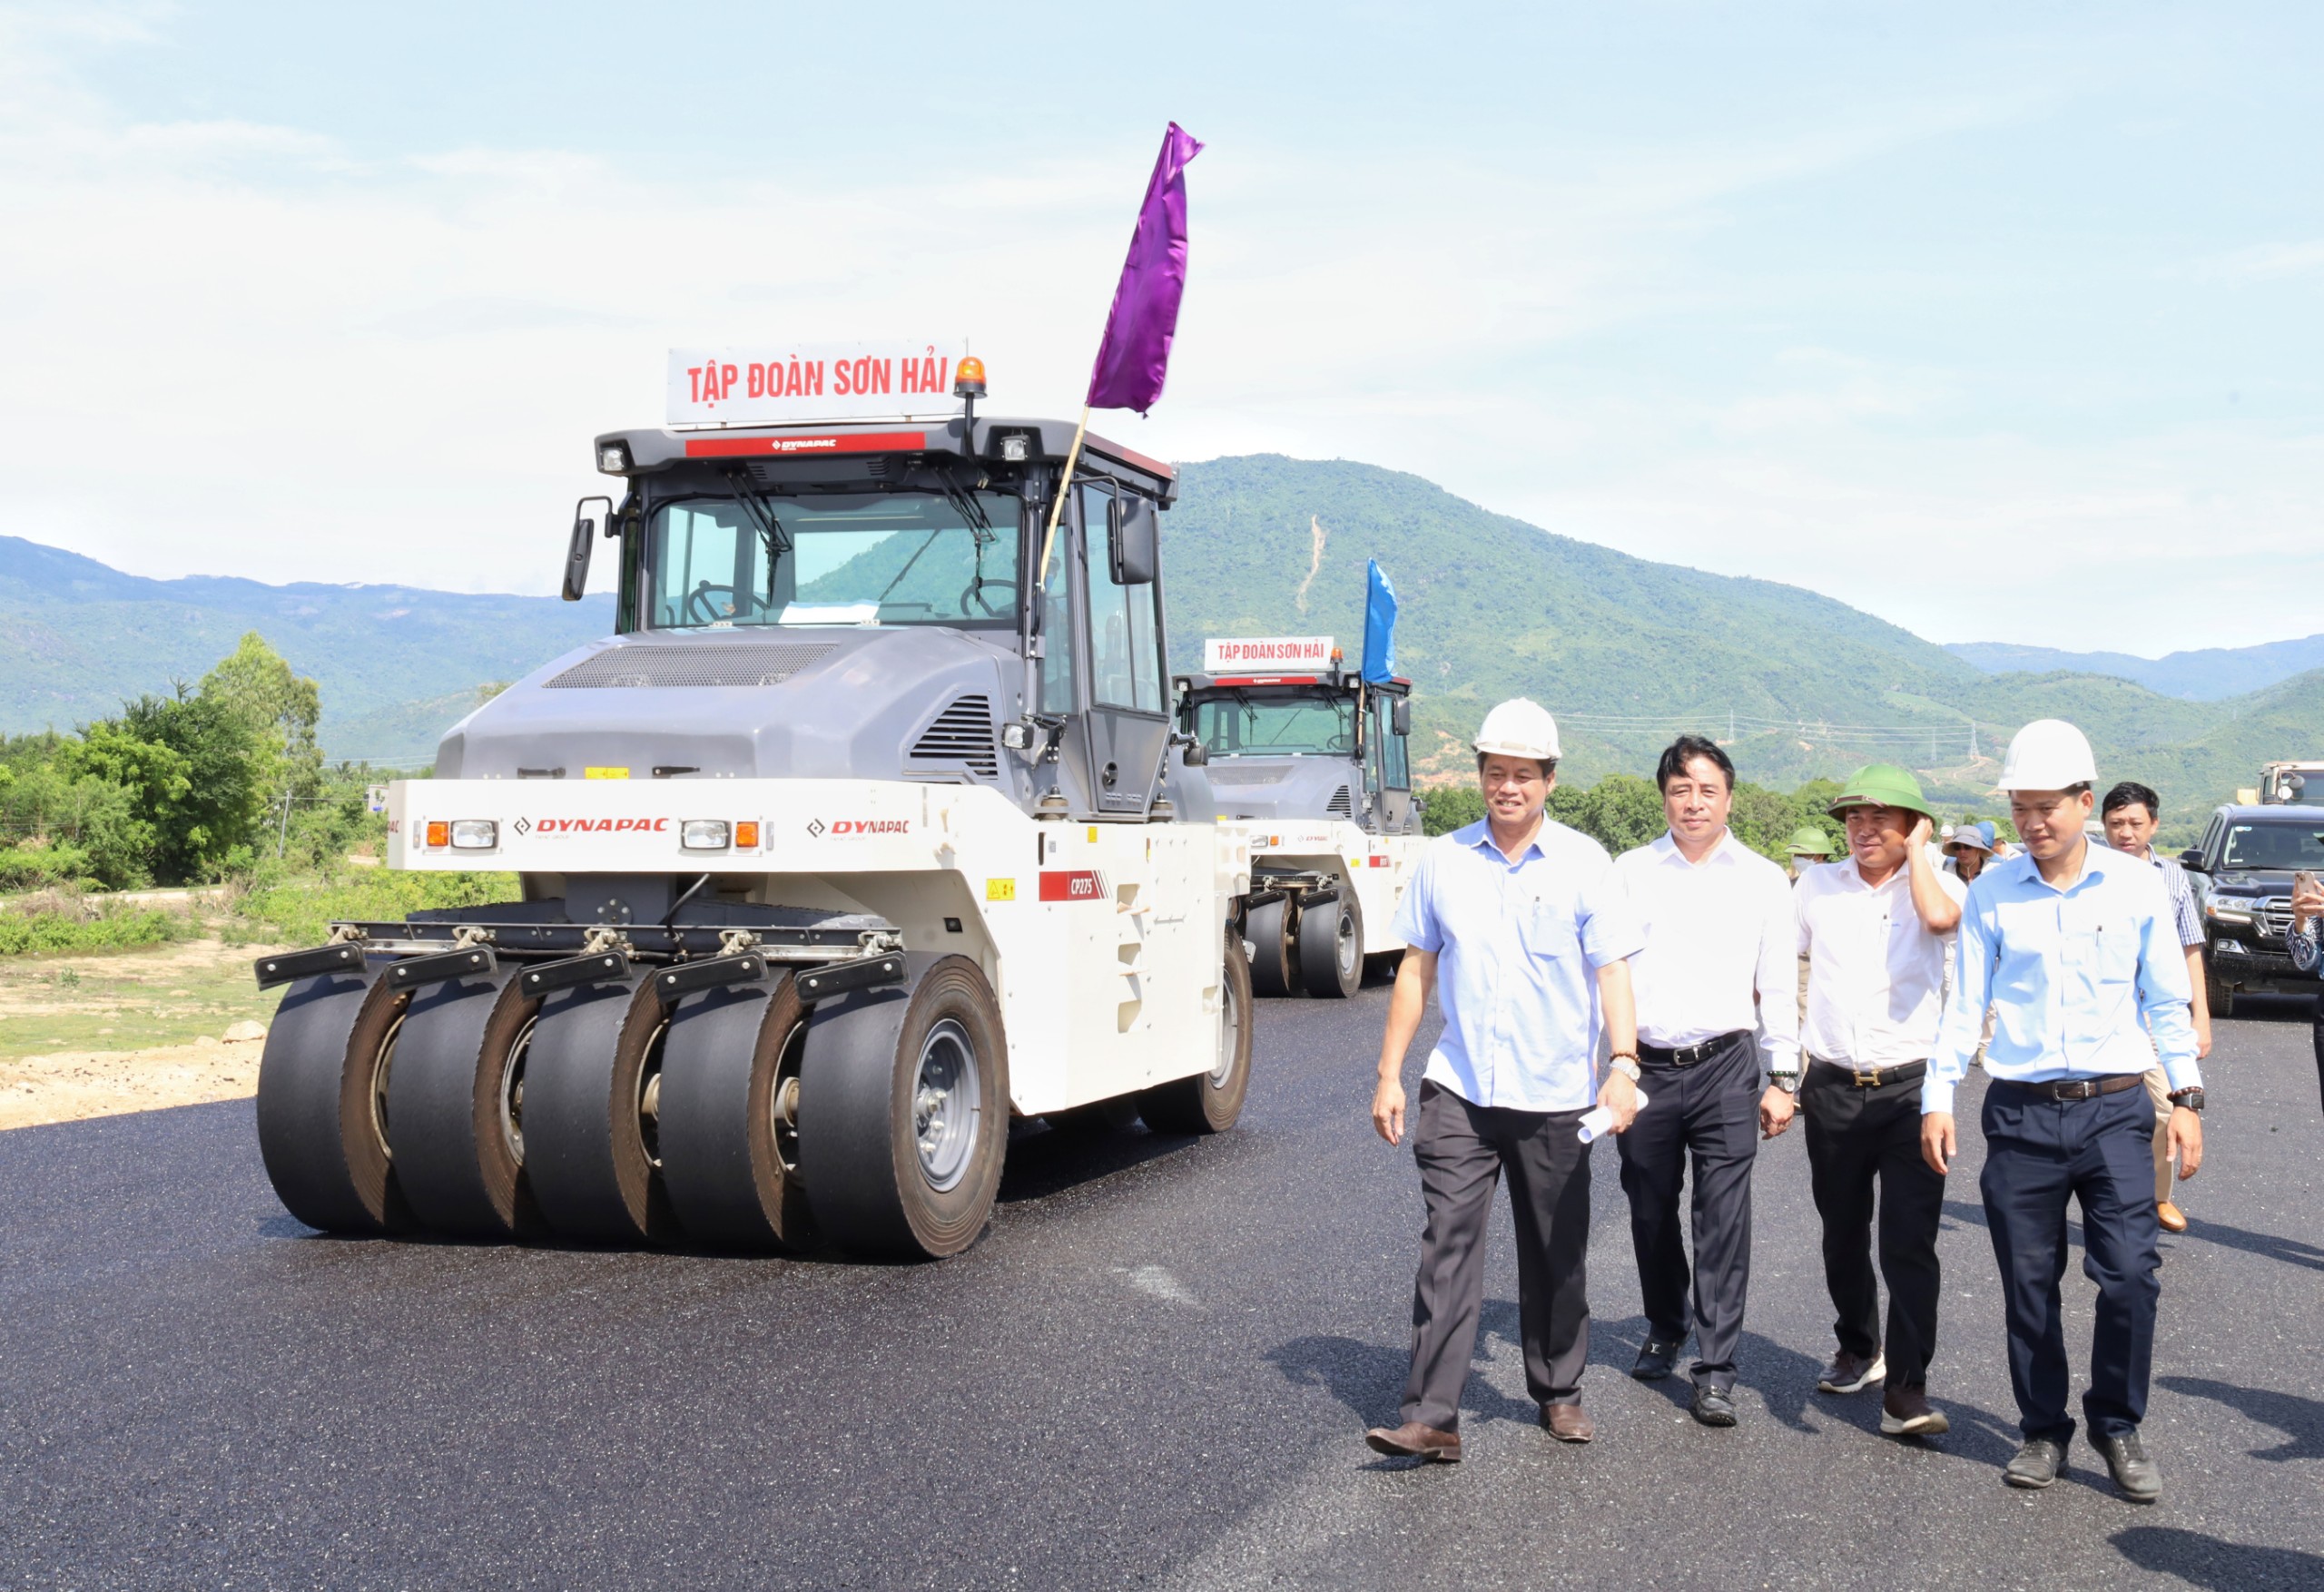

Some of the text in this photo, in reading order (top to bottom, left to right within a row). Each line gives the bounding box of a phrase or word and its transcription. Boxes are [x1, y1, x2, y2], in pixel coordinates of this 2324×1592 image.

[687, 345, 948, 408] TẬP ĐOÀN SƠN HẢI
[782, 439, 837, 448] DYNAPAC
[1218, 639, 1324, 663] TẬP ĐOÀN SƠN HẢI
[537, 818, 669, 832] DYNAPAC
[832, 821, 909, 833] DYNAPAC
[1071, 879, 1093, 895] CP275
